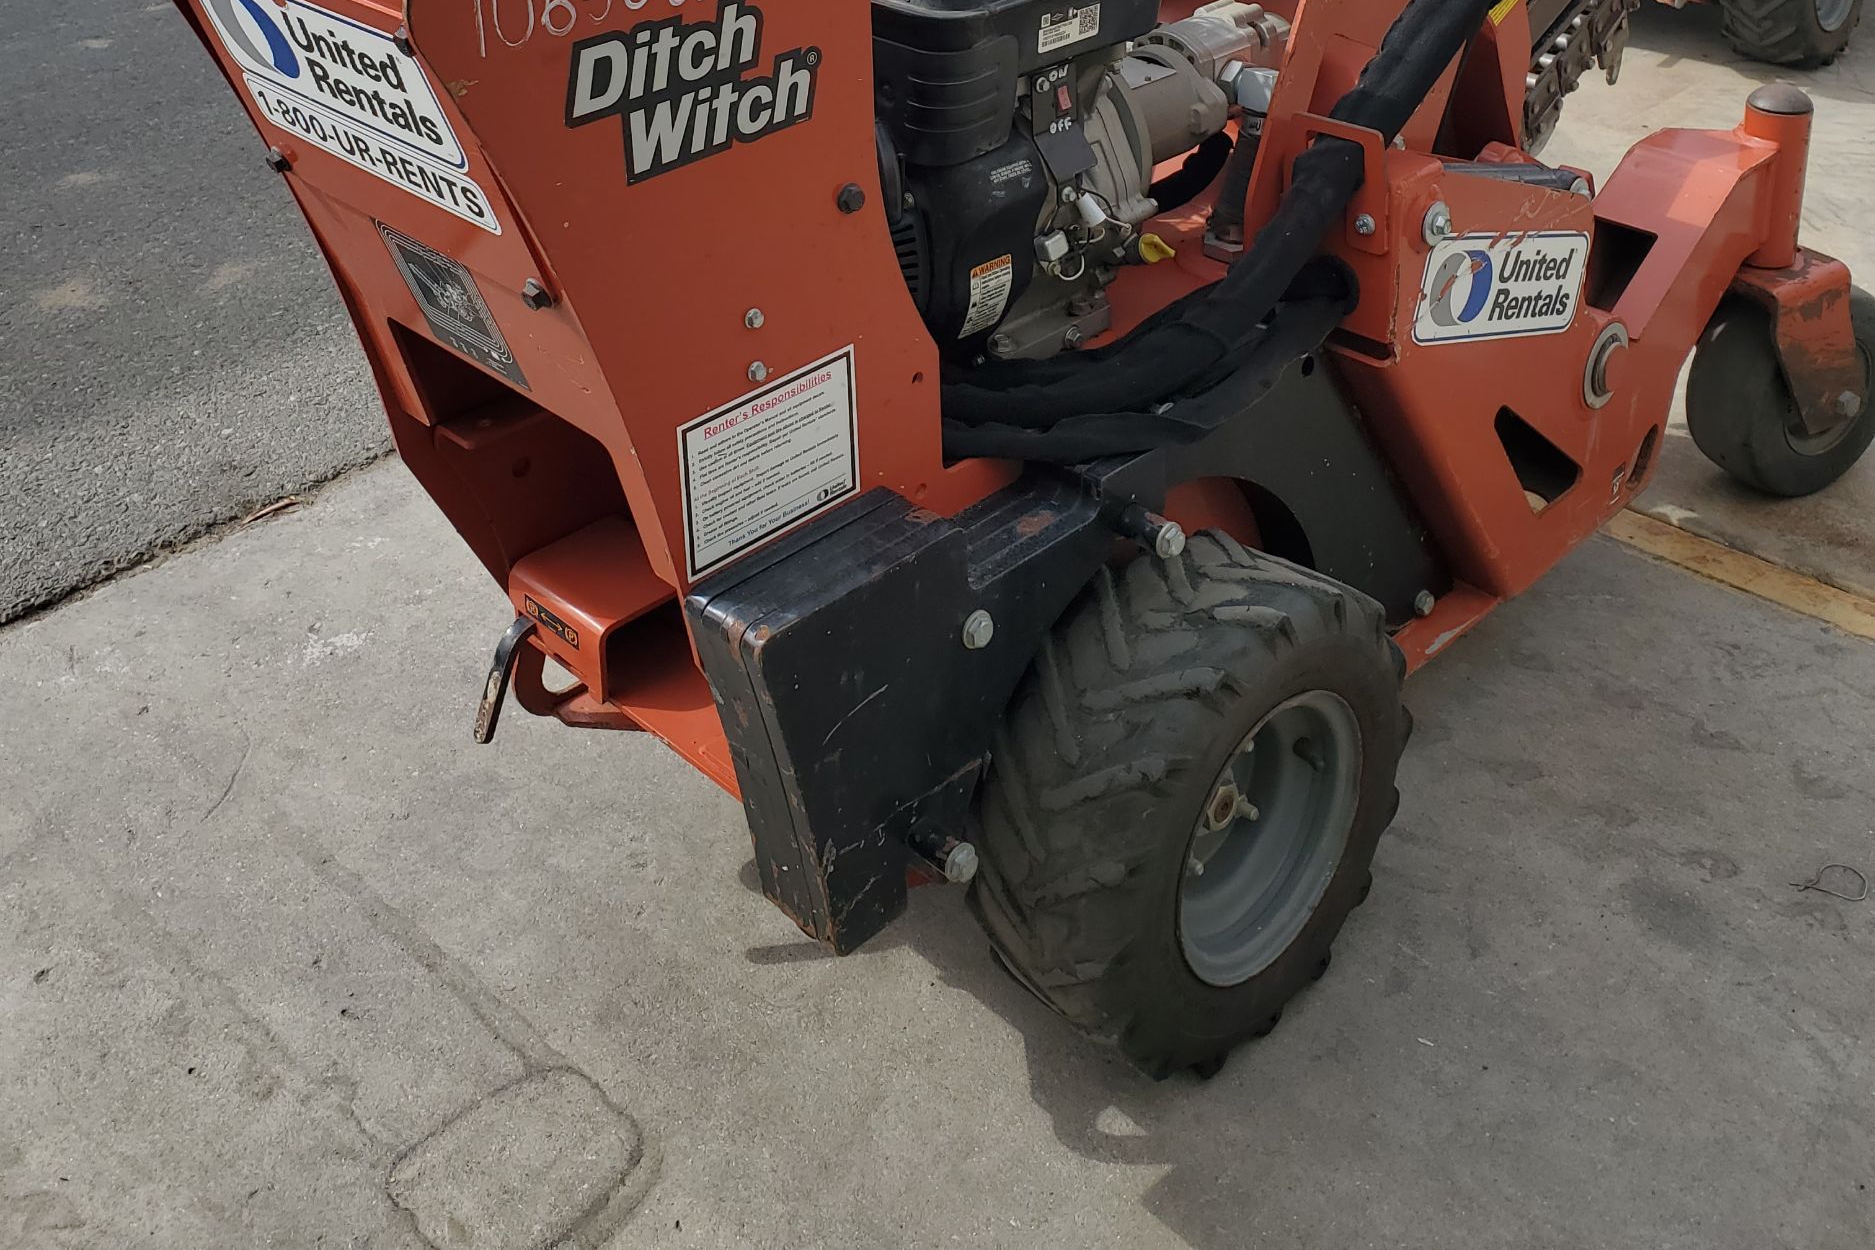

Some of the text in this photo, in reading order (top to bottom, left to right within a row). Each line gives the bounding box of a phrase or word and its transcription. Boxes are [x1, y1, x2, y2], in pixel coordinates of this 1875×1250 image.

[281, 11, 407, 93] United
[572, 2, 758, 120] Ditch
[1049, 63, 1069, 82] ON
[305, 56, 444, 146] Rentals
[629, 60, 813, 176] Witch
[1049, 116, 1072, 134] OFF
[257, 89, 486, 219] 1-800-UR-RENTS
[979, 255, 1010, 276] WARNING
[1498, 248, 1576, 284] United
[1487, 284, 1570, 322] Rentals
[704, 369, 832, 440] Renter's Responsibilities
